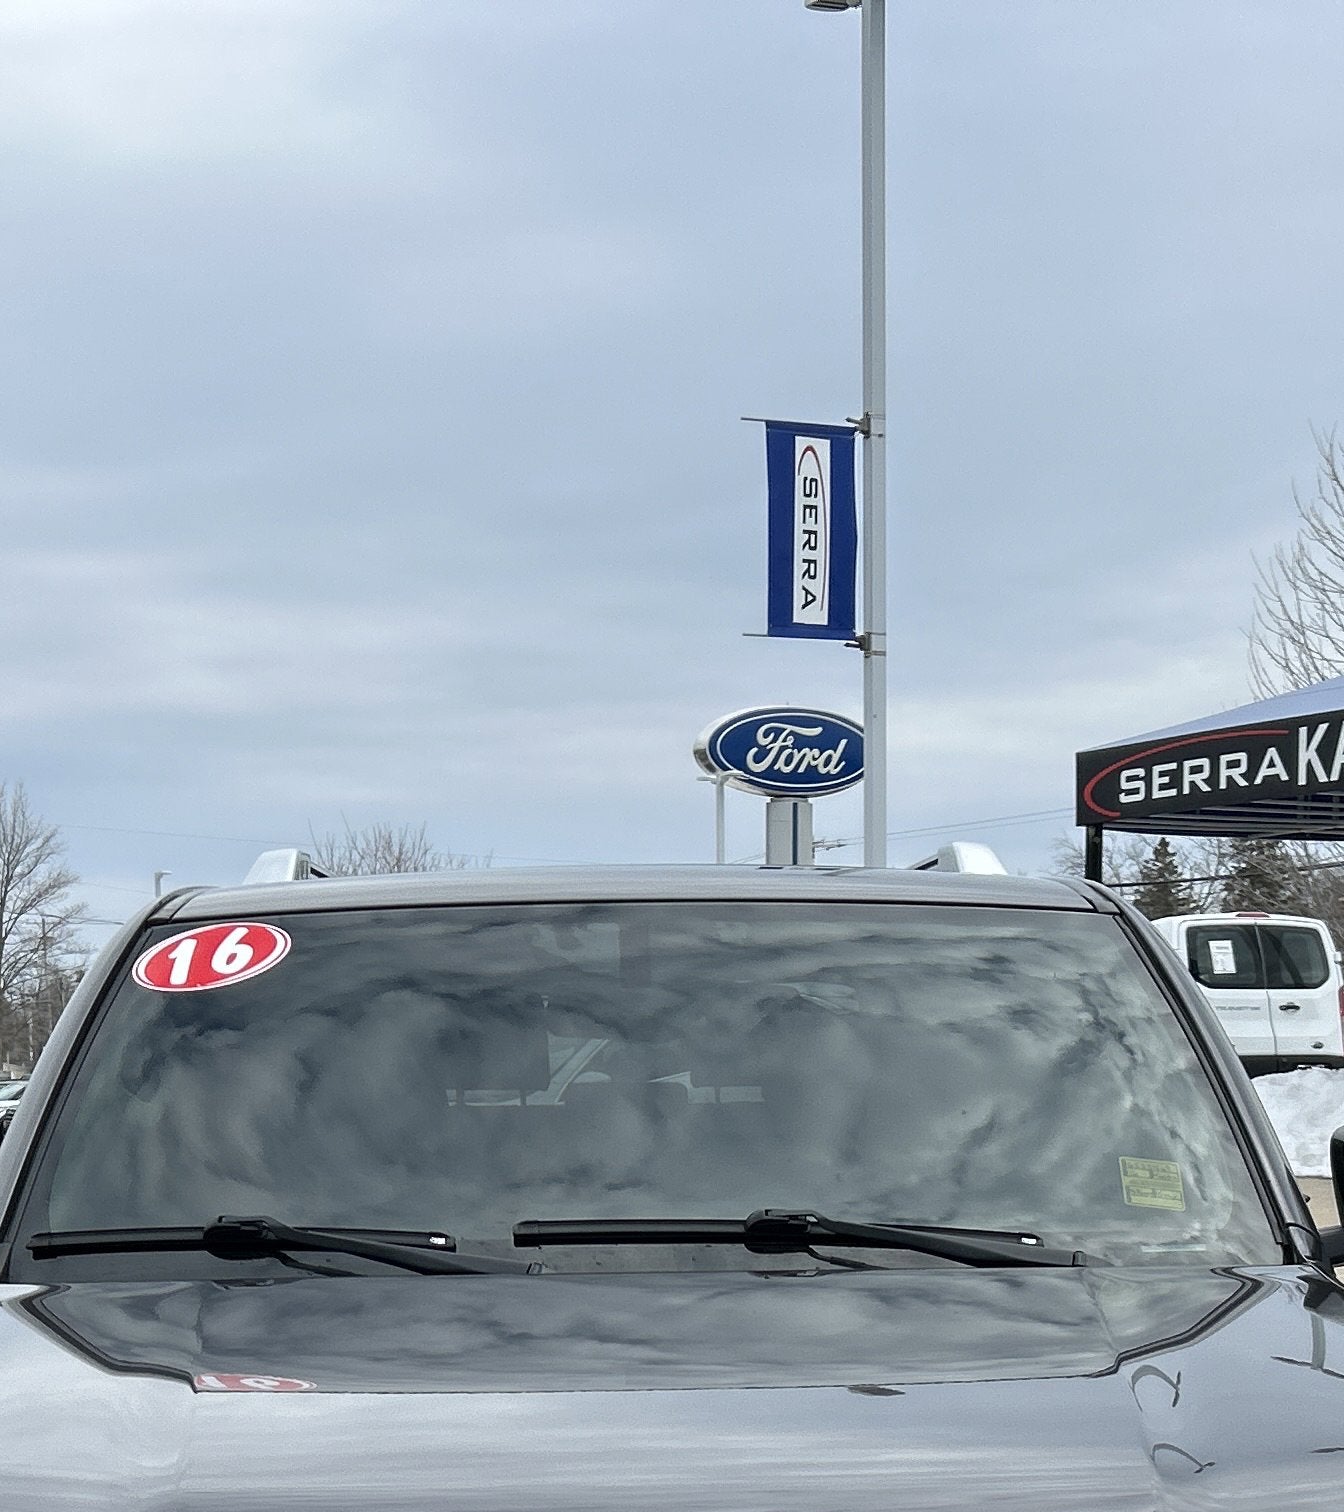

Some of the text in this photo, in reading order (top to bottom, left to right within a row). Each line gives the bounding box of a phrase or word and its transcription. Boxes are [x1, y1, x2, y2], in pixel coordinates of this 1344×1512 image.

[801, 476, 818, 610] SERRA
[746, 722, 849, 775] Ford
[1118, 746, 1290, 804] SERRA
[168, 926, 254, 985] 16
